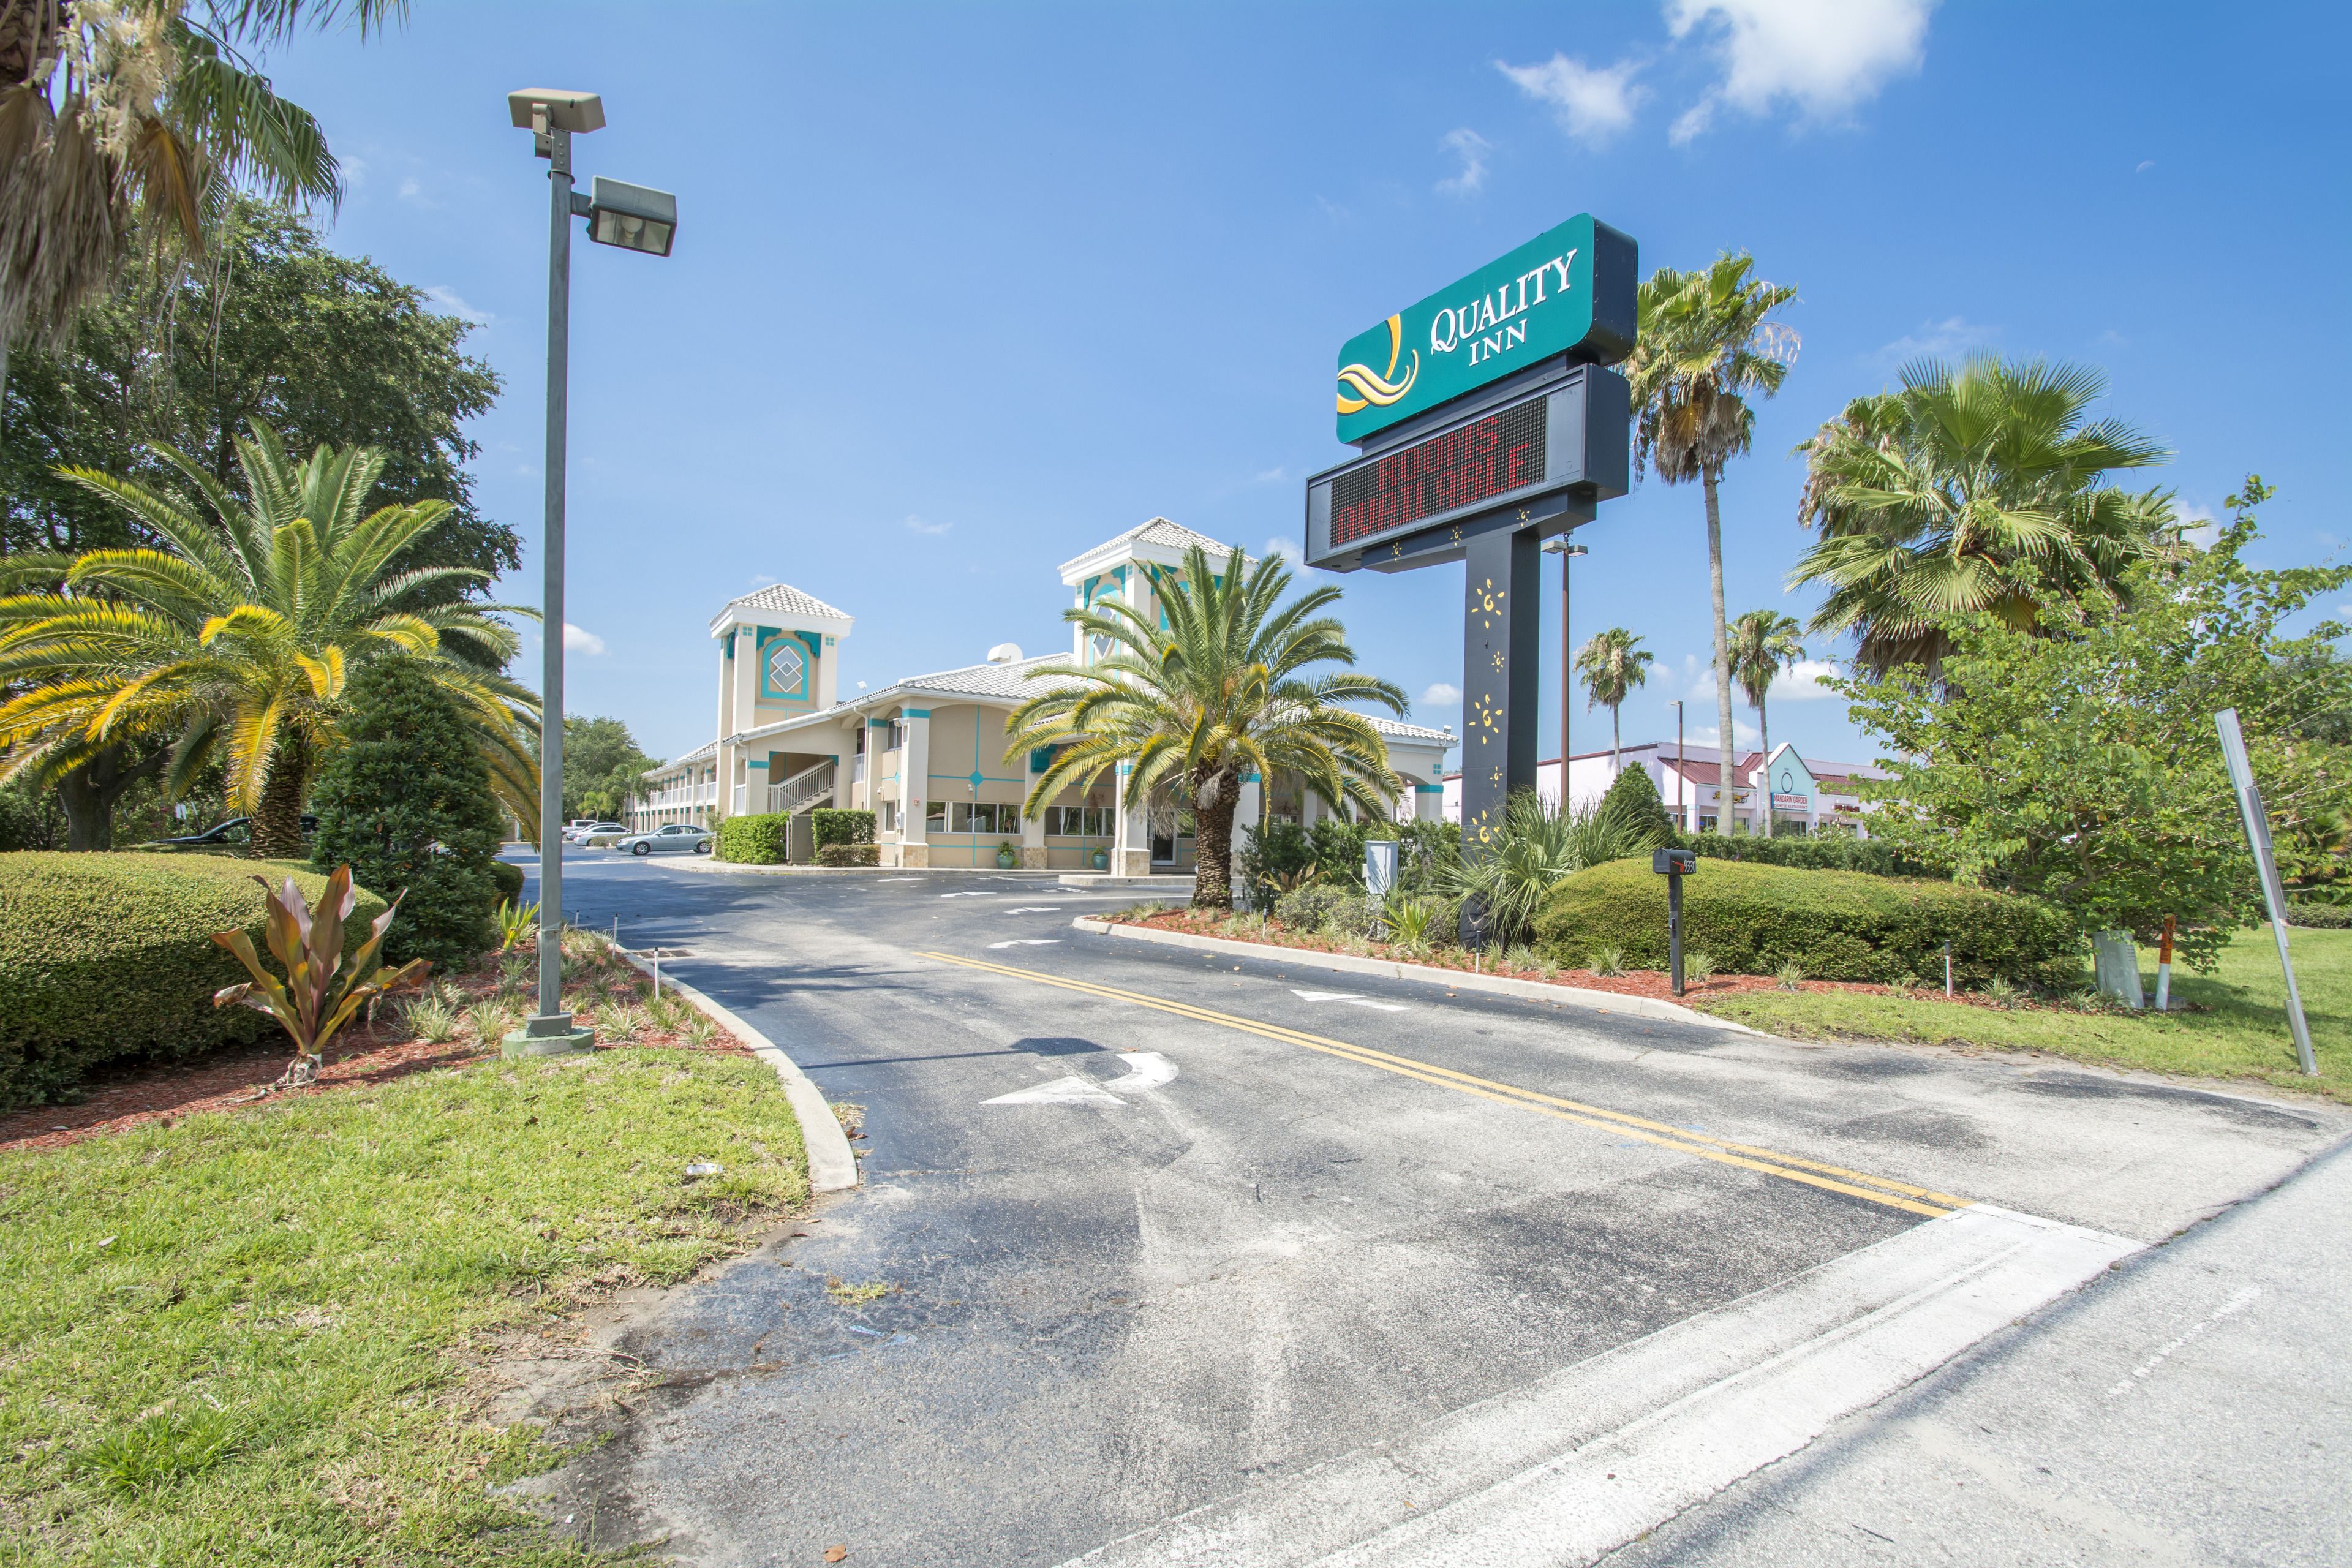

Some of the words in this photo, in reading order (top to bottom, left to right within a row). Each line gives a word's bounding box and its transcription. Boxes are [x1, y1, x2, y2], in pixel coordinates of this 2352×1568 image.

[1431, 248, 1578, 355] QUALITY
[1469, 318, 1528, 367] INN
[1378, 415, 1499, 492] ROOMS
[1774, 794, 1793, 803] MANDARIN
[1684, 859, 1696, 873] 9330
